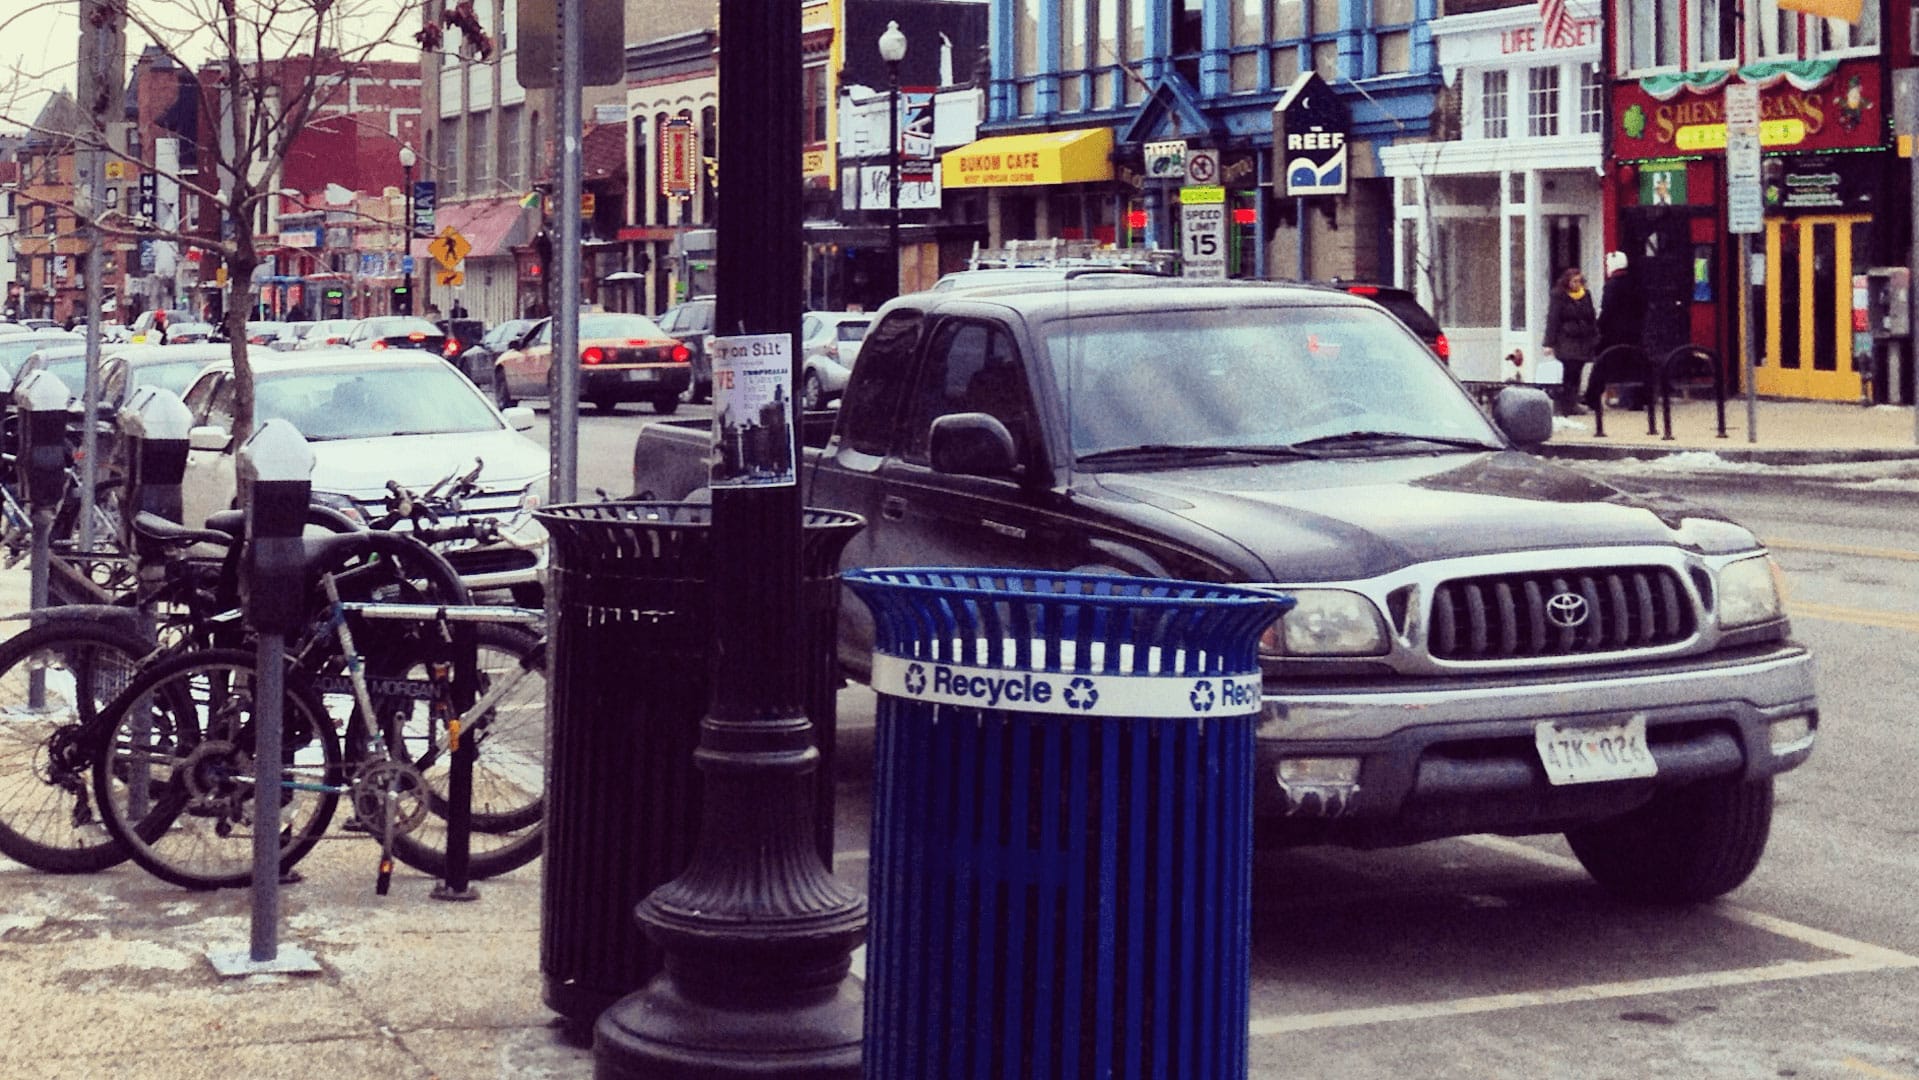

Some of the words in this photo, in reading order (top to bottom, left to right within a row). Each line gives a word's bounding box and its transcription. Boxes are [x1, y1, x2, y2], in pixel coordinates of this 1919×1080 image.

[1501, 28, 1535, 54] LIFE
[1288, 132, 1344, 150] REEF
[960, 155, 1001, 173] BUKOM
[1007, 151, 1039, 170] CAFE
[1184, 210, 1221, 220] SPEED
[1188, 222, 1217, 232] LIMIT
[1190, 234, 1217, 255] 15
[752, 342, 782, 356] Silt
[372, 680, 441, 699] MORGAN
[934, 666, 1052, 704] Recycle
